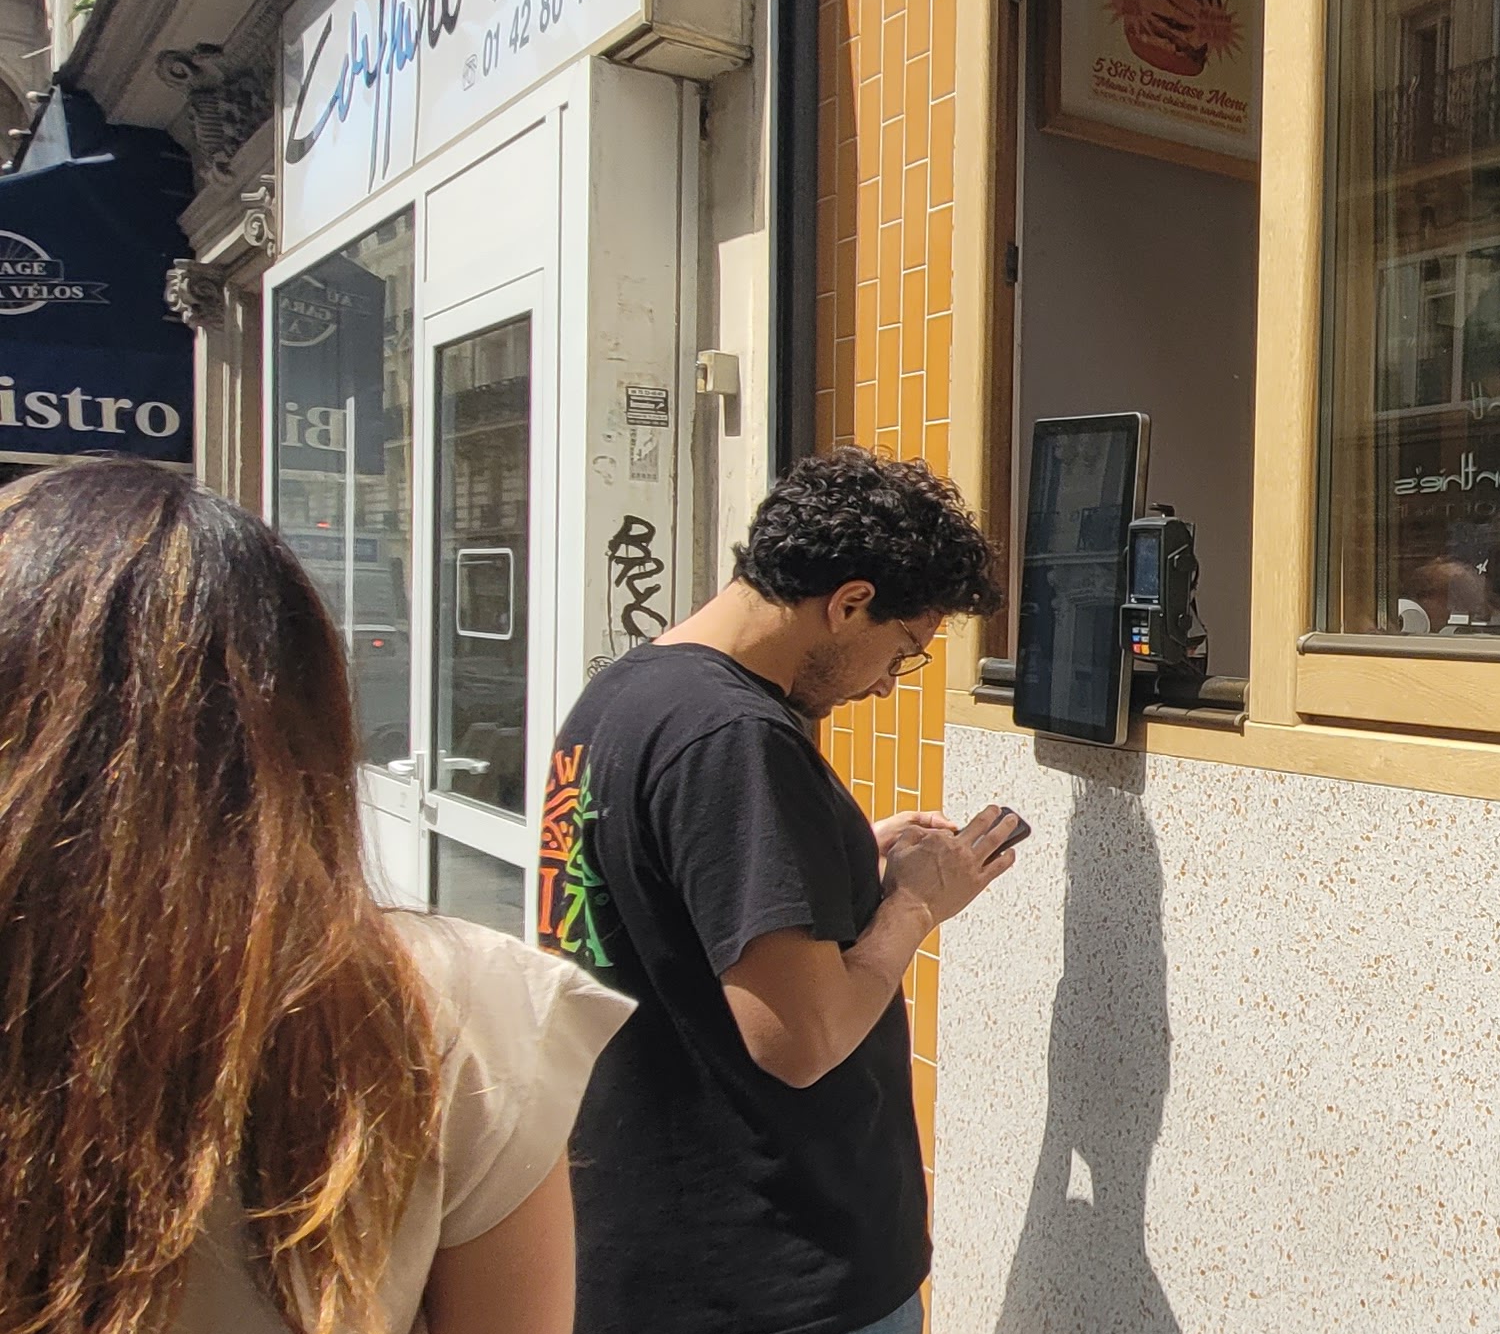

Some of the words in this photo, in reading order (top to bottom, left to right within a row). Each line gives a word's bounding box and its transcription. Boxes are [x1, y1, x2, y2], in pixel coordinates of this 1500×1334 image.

[482, 22, 500, 77] 01
[1093, 57, 1105, 73] 5
[1140, 67, 1204, 99] Omakase
[1206, 89, 1247, 112] Menu
[13, 282, 84, 299] VÉLOS
[0, 376, 180, 437] istro
